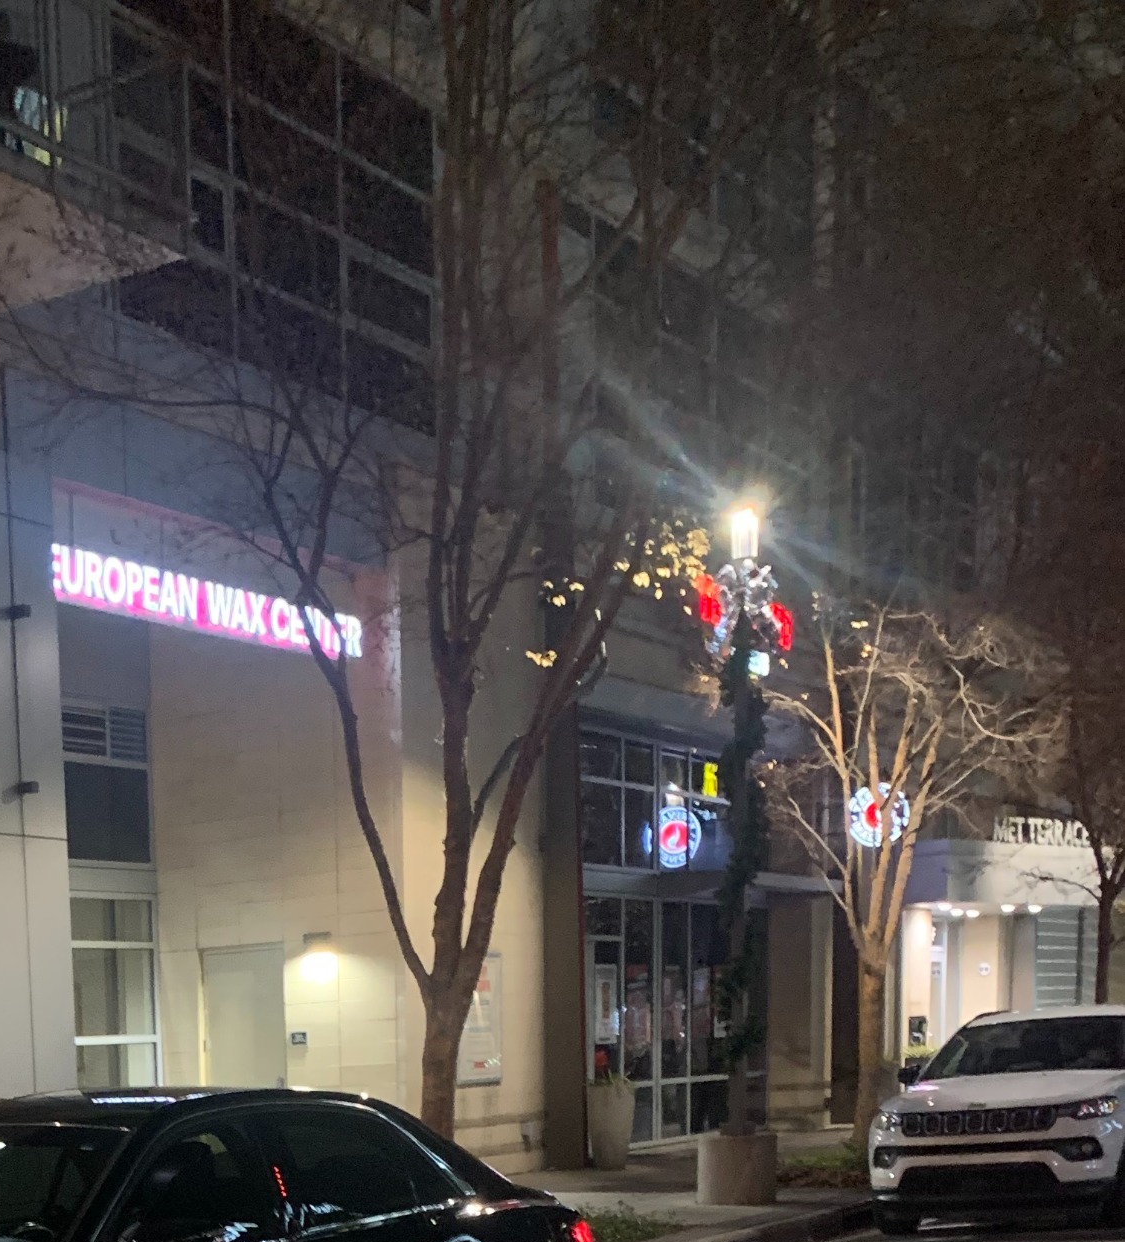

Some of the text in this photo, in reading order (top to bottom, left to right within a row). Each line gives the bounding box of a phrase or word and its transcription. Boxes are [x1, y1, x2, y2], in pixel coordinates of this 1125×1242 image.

[205, 580, 266, 634] WAX
[993, 817, 1091, 848] MET TERRACE
